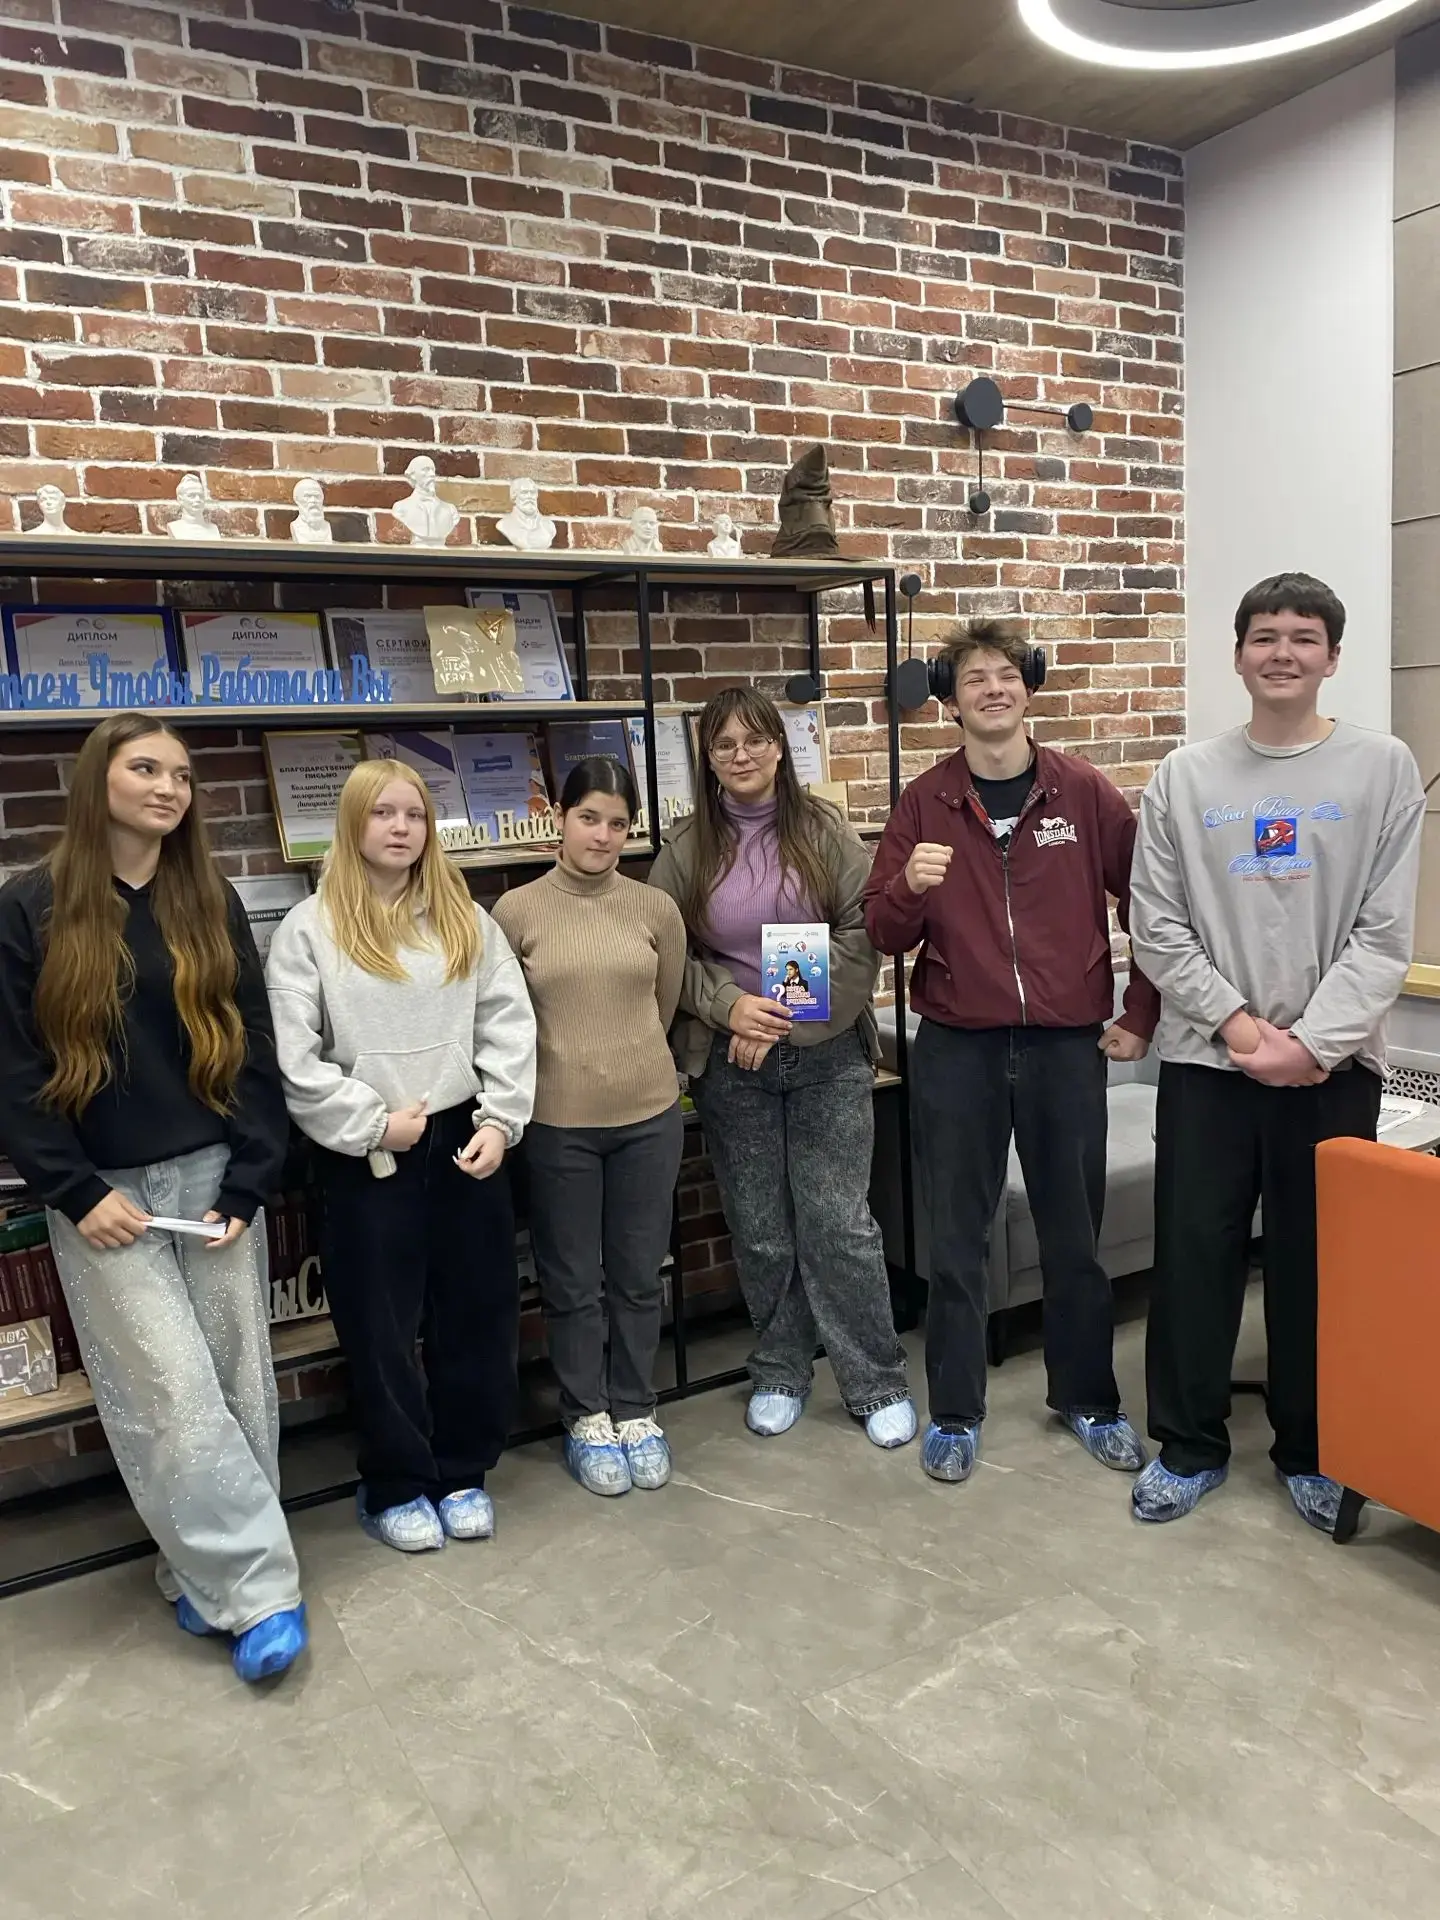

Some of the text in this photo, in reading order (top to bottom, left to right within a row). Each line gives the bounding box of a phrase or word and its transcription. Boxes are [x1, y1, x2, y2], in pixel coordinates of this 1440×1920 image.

[67, 631, 118, 643] ДИПЛОМ
[232, 631, 278, 641] ДИПЛОМ
[376, 639, 430, 648] СЕРТИФИ
[88, 653, 194, 707] Чтобы
[201, 653, 343, 705] Работали
[351, 653, 393, 704] Вы
[494, 806, 563, 845] Найд
